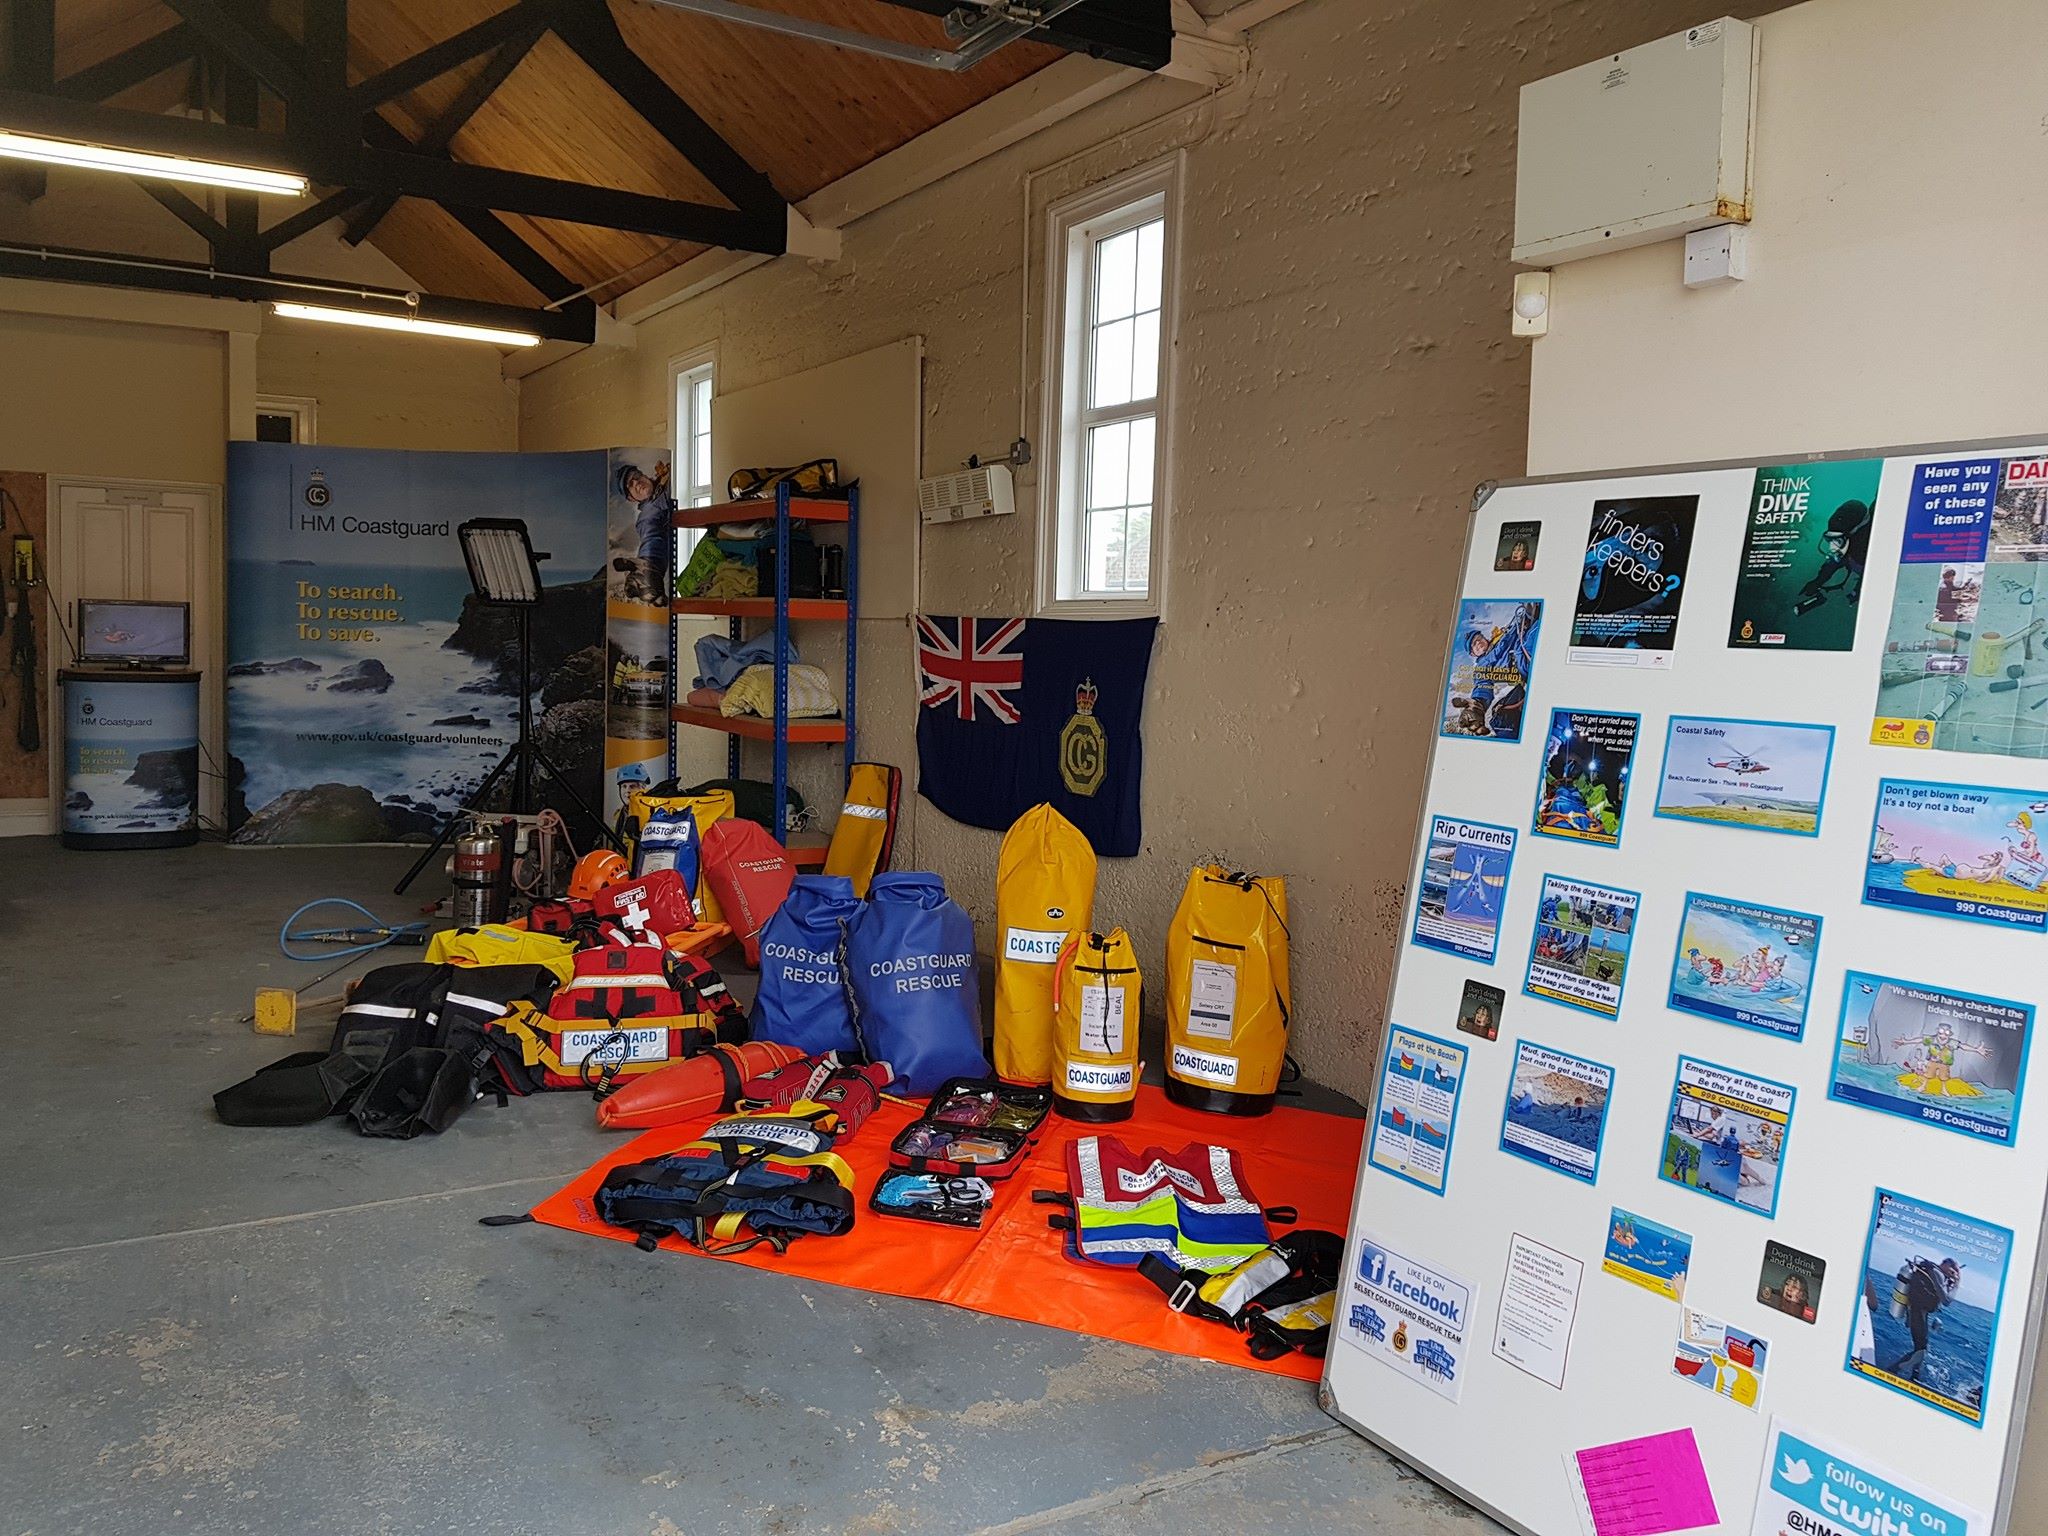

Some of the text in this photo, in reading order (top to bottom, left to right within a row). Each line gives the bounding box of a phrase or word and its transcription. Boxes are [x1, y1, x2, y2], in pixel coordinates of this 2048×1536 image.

[1925, 466, 1991, 478] Have you
[1762, 477, 1812, 493] THINK
[1924, 481, 1989, 494] seen any
[1757, 493, 1809, 513] DIVE
[1925, 497, 1986, 510] of these
[301, 514, 449, 538] HM Coastguard
[1755, 512, 1805, 525] SAFETY
[1934, 512, 1984, 525] items?
[1597, 509, 1664, 561] finders
[1587, 532, 1680, 598] keepers?
[296, 581, 403, 601] To search.
[296, 602, 405, 623] To rescue.
[296, 624, 380, 642] To save.
[81, 718, 152, 727] HM Coastguard
[1572, 714, 1587, 722] Don't
[1588, 716, 1598, 724] get
[1620, 718, 1636, 727] away
[1573, 724, 1586, 733] Stay
[296, 732, 503, 746] www.gov.uk/coastguard-volunteers
[1617, 738, 1633, 746] drink
[1676, 726, 1726, 737] Coastal Safety
[1750, 783, 1783, 792] Coastguard
[1885, 786, 1989, 805] Don't get blown away
[1883, 798, 1896, 807] It's
[1907, 799, 1922, 811] toy
[1925, 802, 1941, 811] not
[1952, 804, 1975, 814] boat
[643, 826, 687, 836] COASTGUARD
[1436, 821, 1512, 845] Rip Currents
[753, 864, 782, 872] RESCUE
[616, 896, 633, 906] FIRST
[1547, 879, 1635, 904] Taking the dog for walk?
[1737, 907, 1762, 917] should
[1763, 911, 1772, 919] be
[1773, 914, 1788, 922] one
[1790, 916, 1801, 925] for
[1802, 918, 1814, 928] all,
[1956, 902, 2044, 924] 999 Coastguard
[1758, 921, 1794, 933] not for
[765, 942, 838, 965] COASTGU
[1010, 937, 1060, 954] COASTG
[1463, 946, 1492, 959] Coastguard
[783, 966, 842, 985] RESCU
[870, 953, 972, 978] COASTGUARD
[896, 972, 962, 993] RESCUE
[1532, 965, 1610, 992] Stay from cliff edges
[1543, 977, 1557, 988] keep
[1573, 986, 1585, 995] dog
[1601, 993, 1616, 1003] lead.
[1907, 989, 1939, 1003] should
[1940, 995, 1963, 1008] have
[1965, 1000, 2006, 1015] checked
[2008, 1009, 2024, 1020] the
[1927, 1004, 1950, 1017] tides
[1952, 1009, 1983, 1024] before
[1985, 1016, 1999, 1026] we
[1736, 1011, 1799, 1033] 999 Coastguard
[1399, 1036, 1457, 1062] Flags at the Beach
[1174, 1052, 1234, 1076] COASTGUARD
[1520, 1054, 1533, 1063] but
[1534, 1058, 1547, 1067] not
[1557, 1065, 1570, 1074] get
[1571, 1070, 1592, 1082] stuck
[1594, 1076, 1604, 1085] in.
[1522, 1045, 1608, 1078] Mud, good for the skin,
[1069, 1068, 1130, 1085] COASTGUARD
[1685, 1062, 1732, 1084] Emergency
[1744, 1079, 1758, 1090] the
[1760, 1084, 1791, 1099] coast?
[1698, 1078, 1773, 1106] Be the first to call
[1701, 1090, 1771, 1118] 999 Coastguard
[1922, 1107, 1942, 1122] 999
[1943, 1112, 2007, 1138] Coastguard
[730, 1127, 786, 1140] RESCUE
[1559, 1159, 1592, 1178] Coastguard
[1914, 1207, 1959, 1228] Remember
[1770, 1256, 1813, 1277] and drown
[1771, 1247, 1817, 1271] Don't drink
[1407, 1267, 1446, 1291] LIKE US ON
[1354, 1281, 1462, 1345] SELSEY COASTGUARD RESCUE TEAM
[1941, 1399, 1978, 1418] Coastguard
[1825, 1461, 1947, 1535] follow us on
